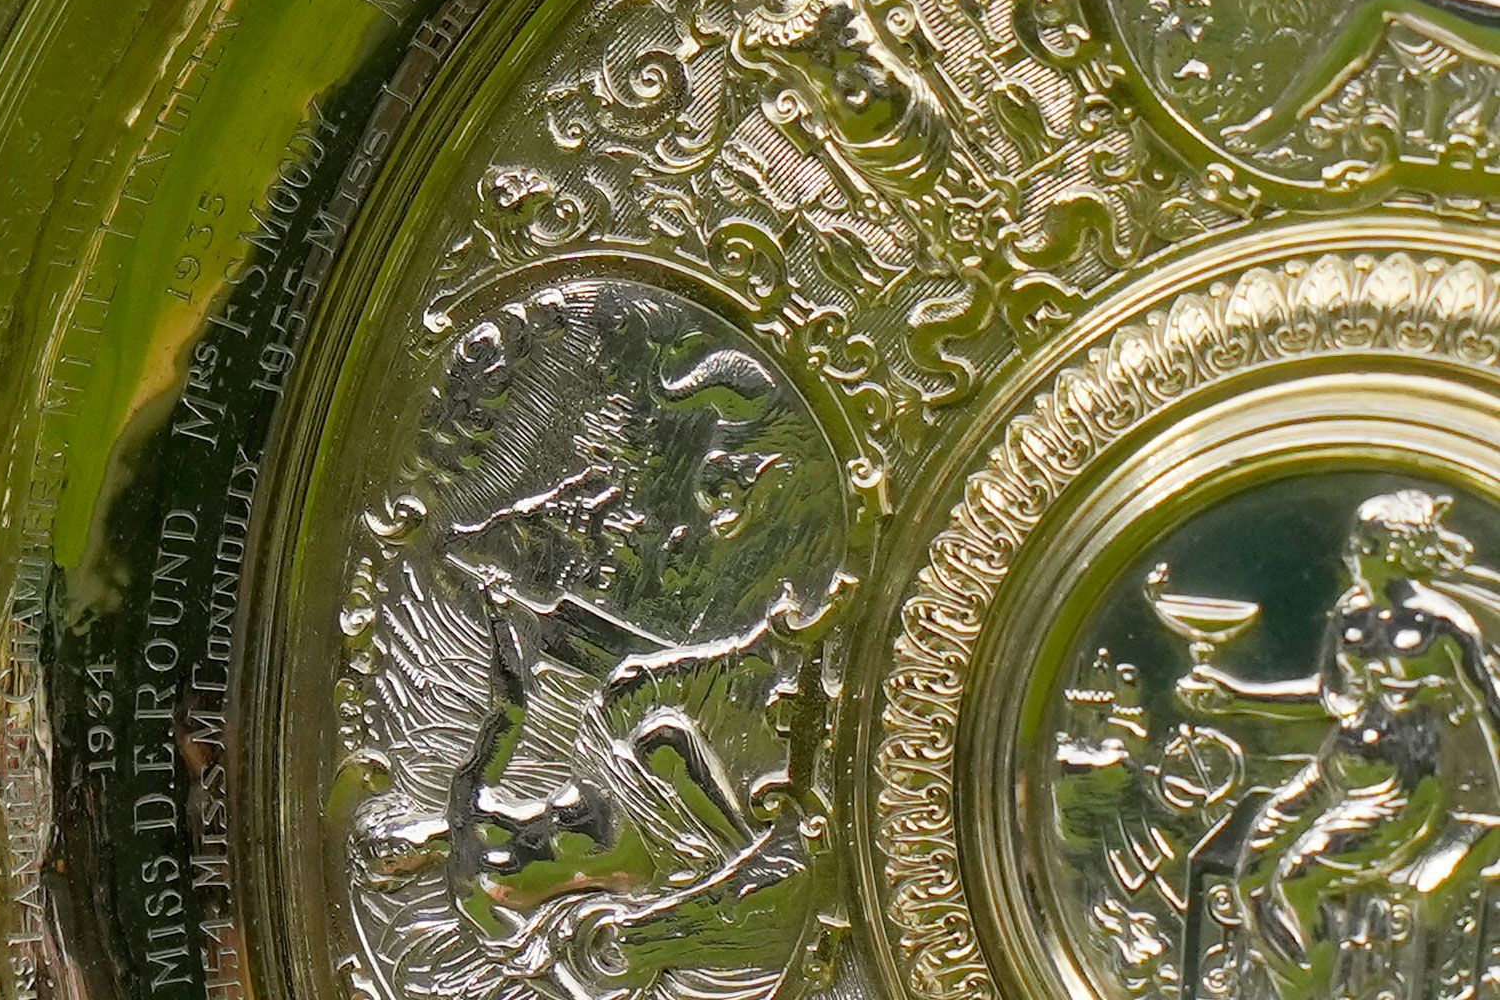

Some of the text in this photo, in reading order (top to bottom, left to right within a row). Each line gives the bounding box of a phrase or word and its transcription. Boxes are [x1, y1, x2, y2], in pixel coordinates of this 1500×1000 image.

[163, 186, 231, 304] 1935
[81, 652, 118, 772] 1934
[137, 852, 195, 992] MISS
